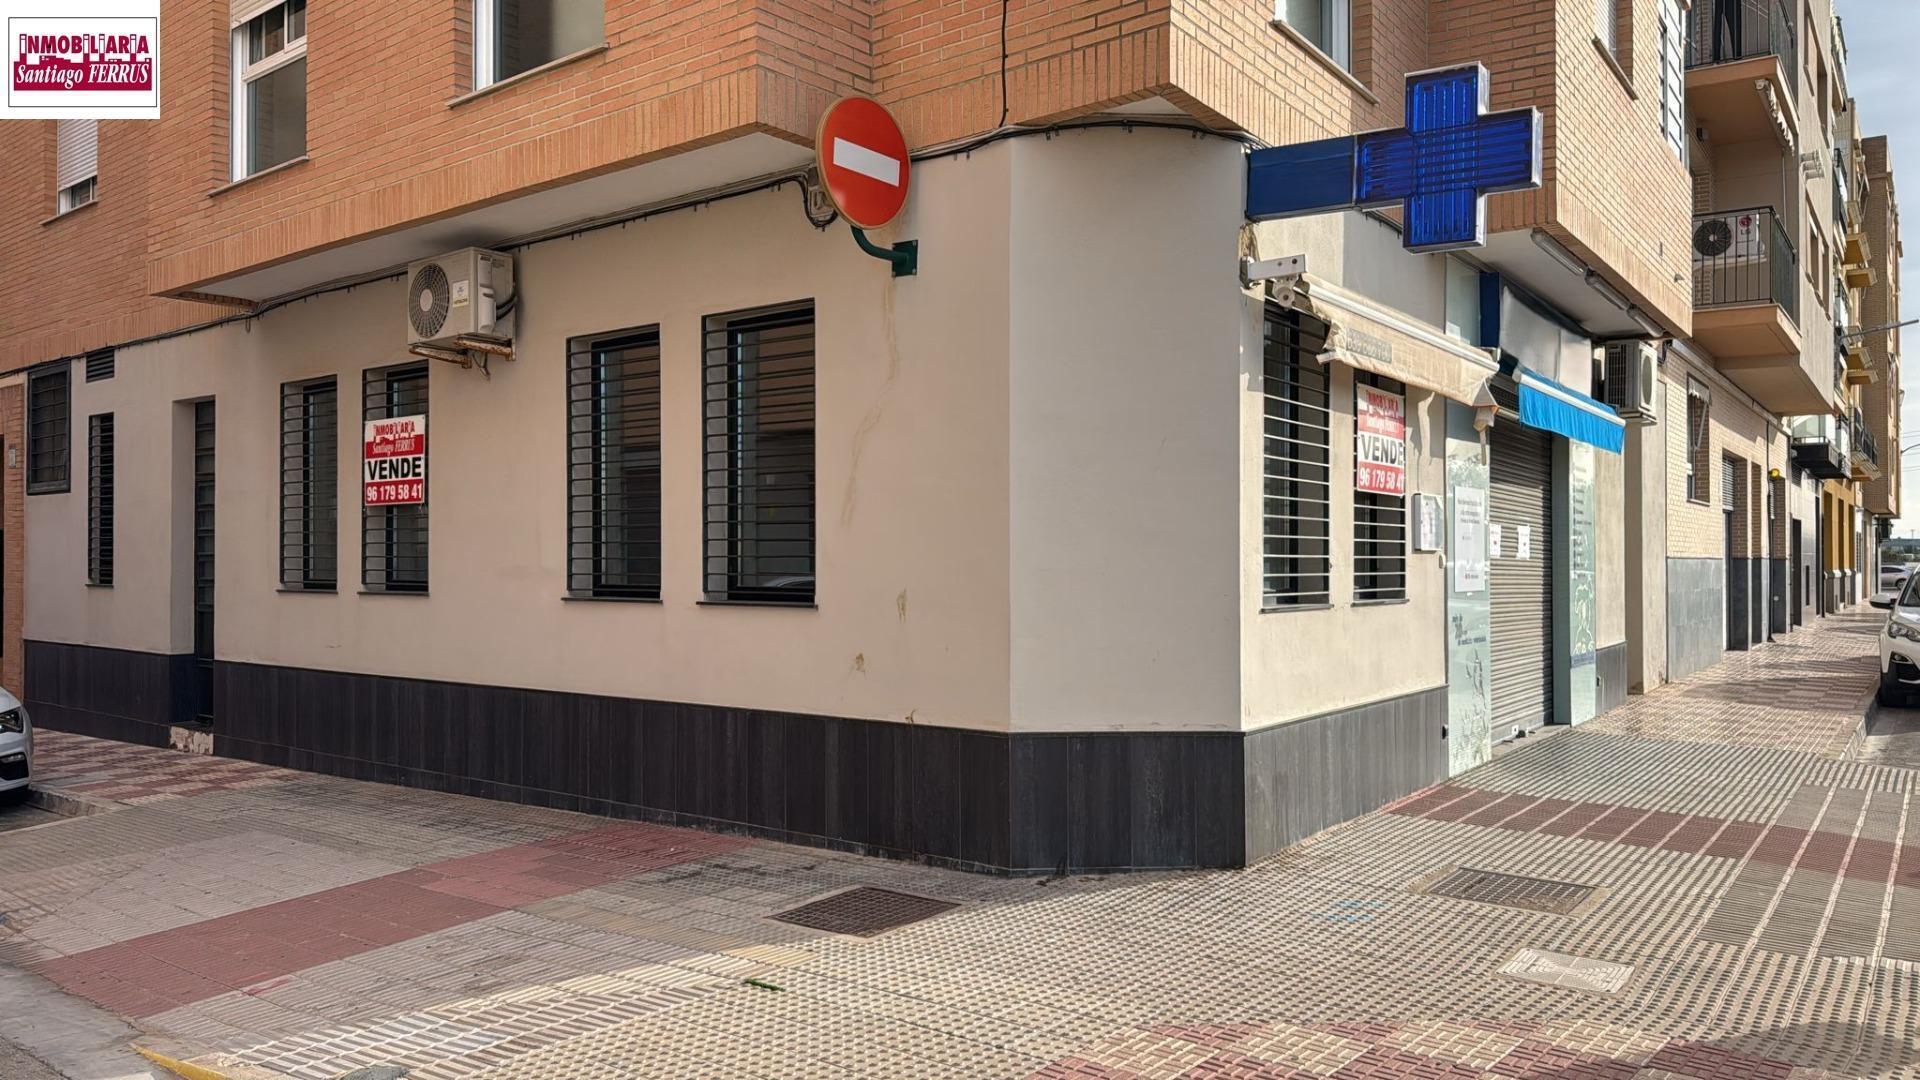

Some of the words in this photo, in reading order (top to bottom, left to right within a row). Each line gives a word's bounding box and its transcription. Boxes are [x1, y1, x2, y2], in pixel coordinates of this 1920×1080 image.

[1360, 434, 1403, 464] VENDE
[367, 456, 422, 480] VENDE
[1359, 467, 1370, 487] 96
[1372, 470, 1385, 488] 179
[367, 486, 377, 501] 96
[380, 485, 396, 500] 179
[398, 484, 410, 500] 58
[411, 483, 422, 499] 41
